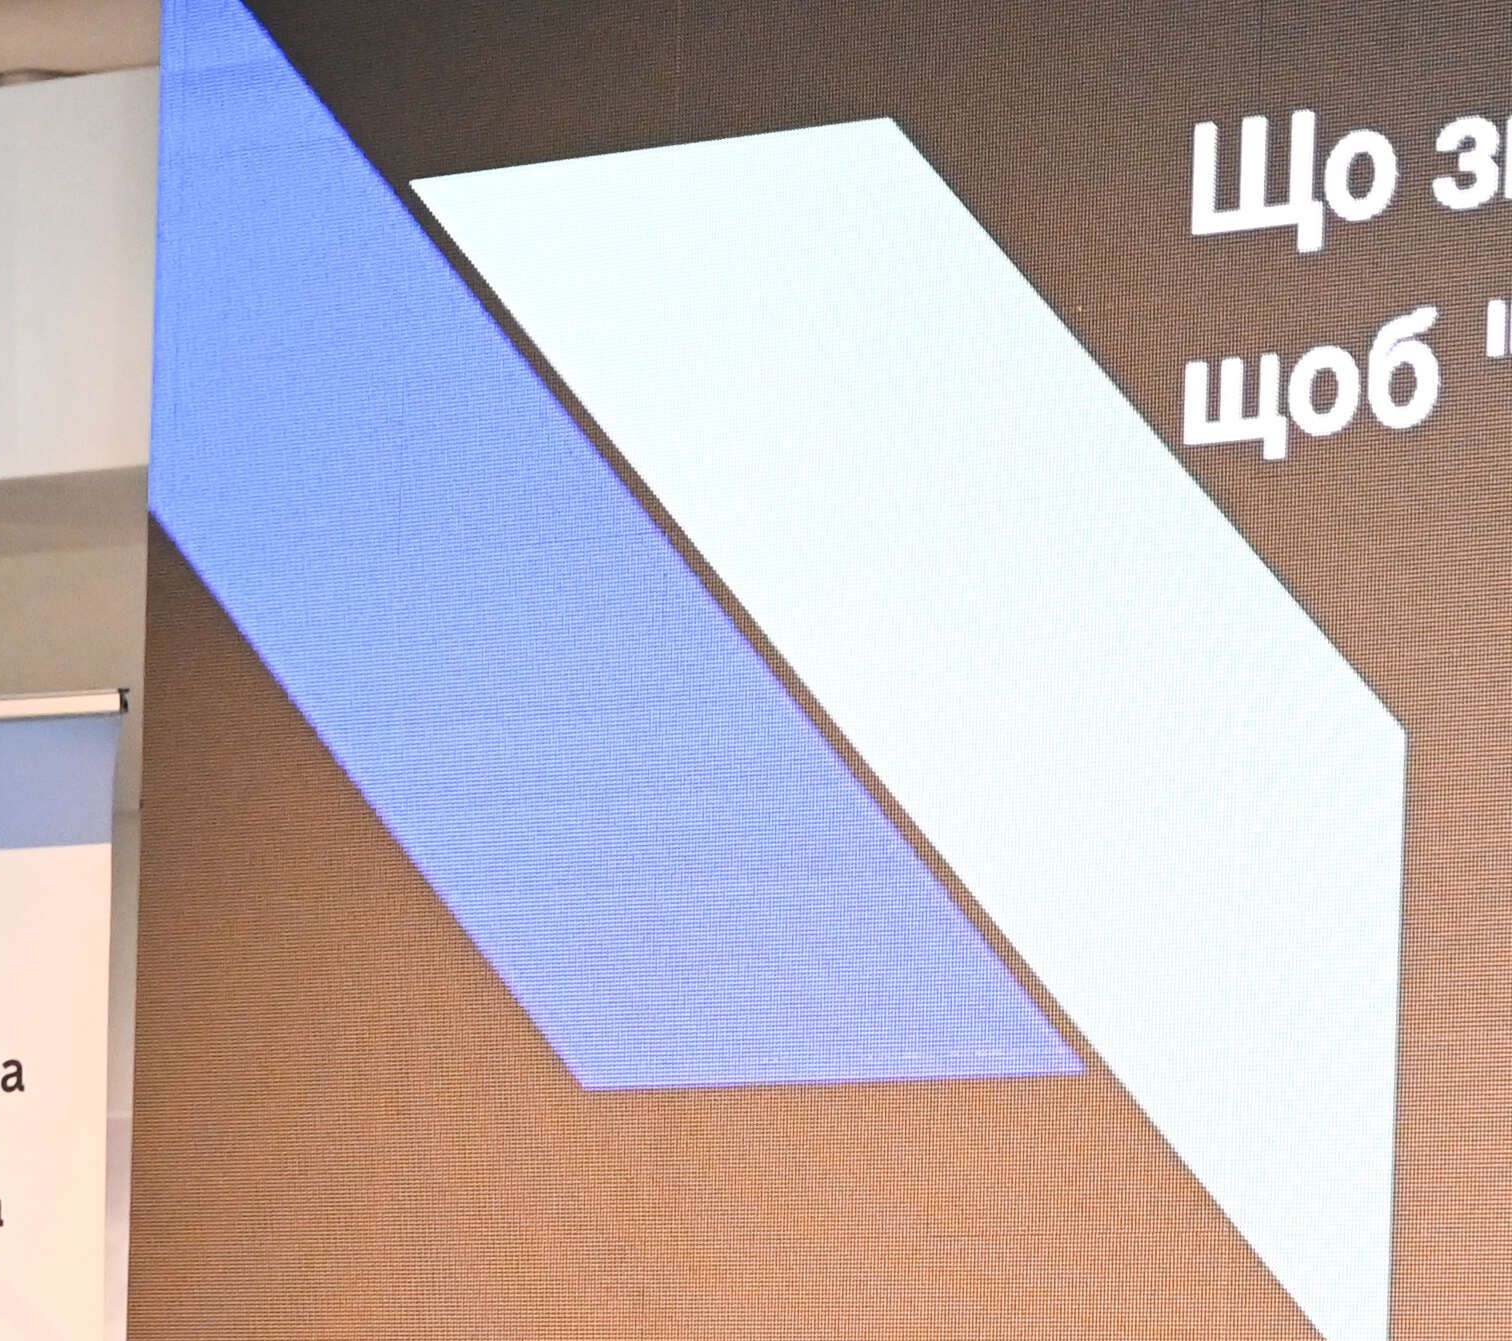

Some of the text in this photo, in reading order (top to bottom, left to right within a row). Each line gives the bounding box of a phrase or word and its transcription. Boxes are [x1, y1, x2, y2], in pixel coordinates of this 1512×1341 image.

[1191, 109, 1512, 253] Що з
[1182, 306, 1440, 460] щоб
